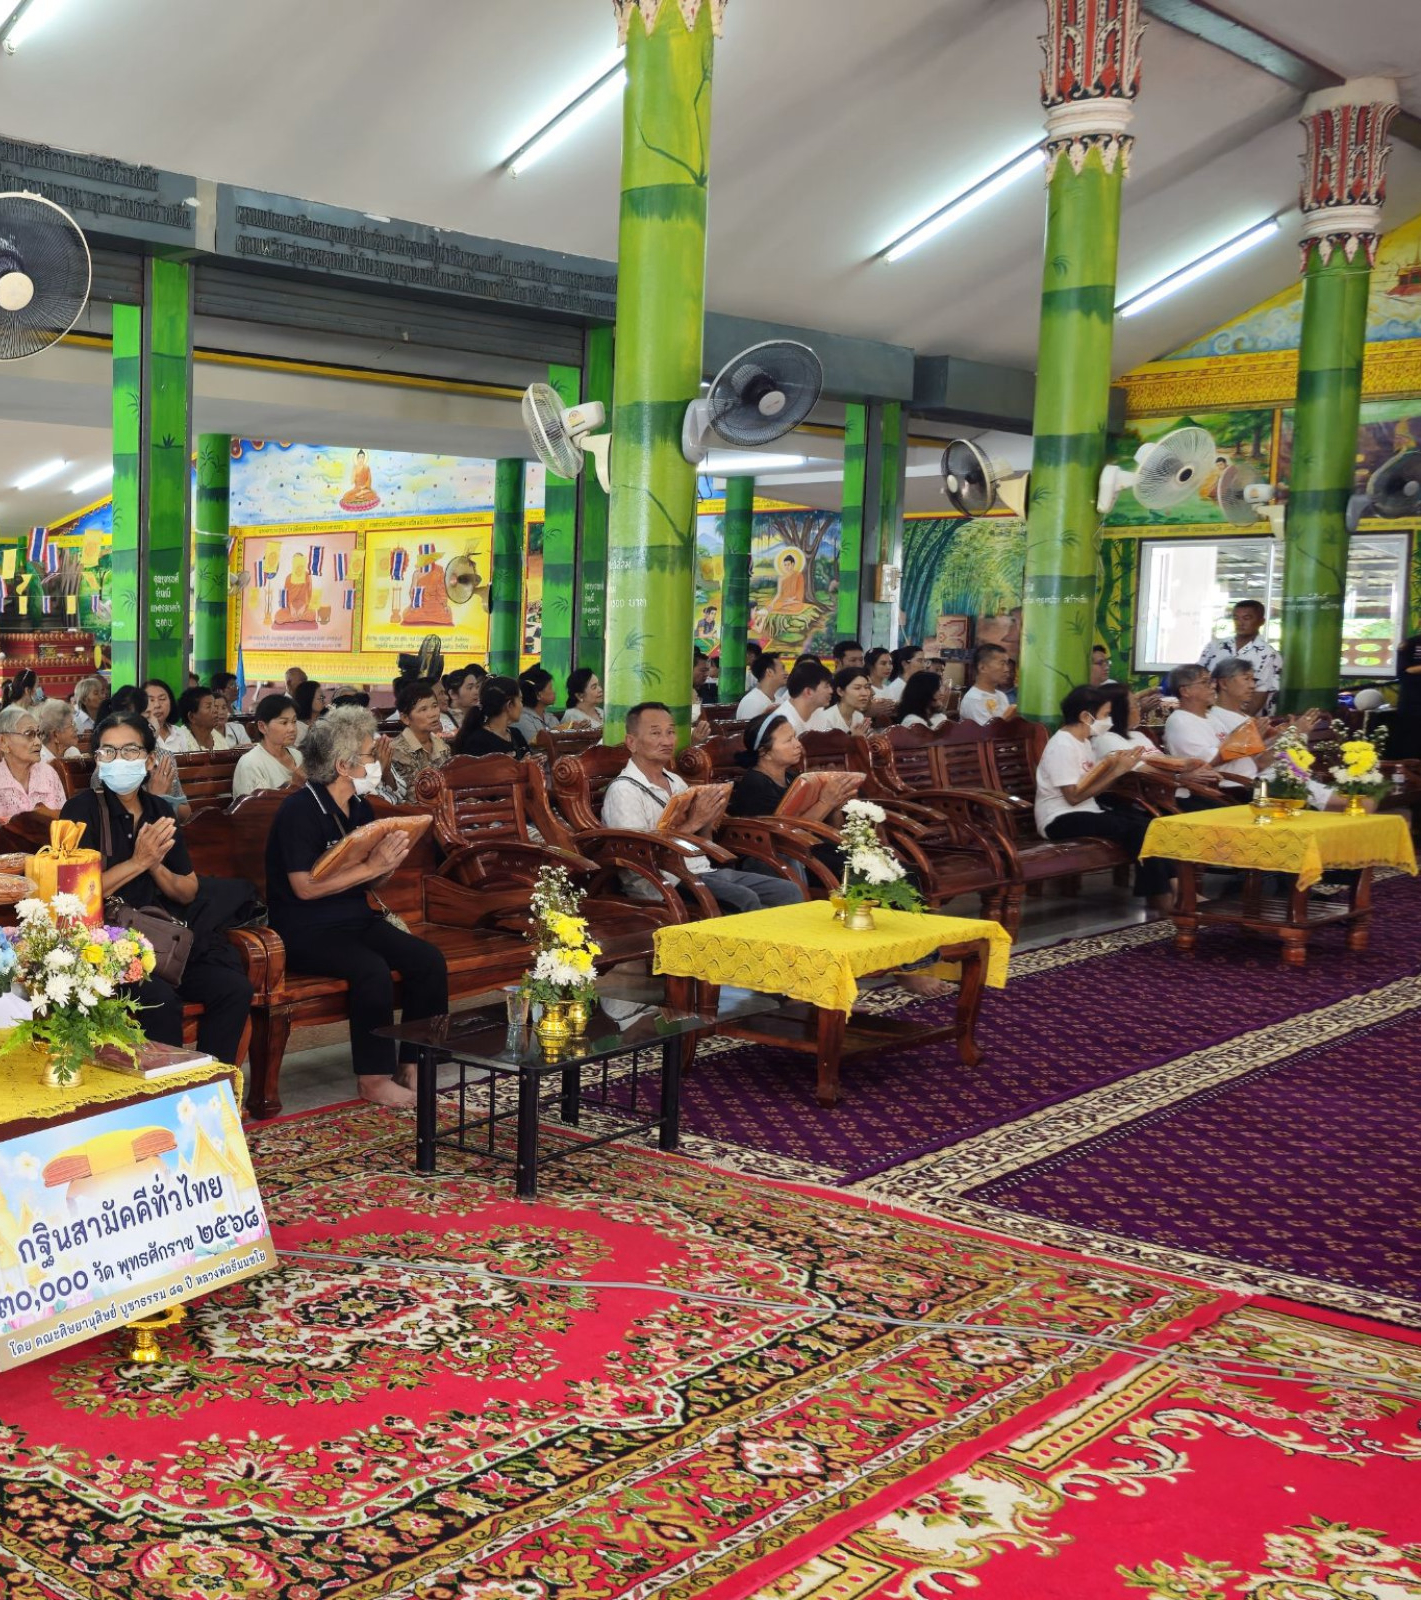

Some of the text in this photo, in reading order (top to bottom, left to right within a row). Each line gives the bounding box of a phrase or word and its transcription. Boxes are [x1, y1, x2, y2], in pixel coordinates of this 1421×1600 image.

[18, 1173, 223, 1268] กฐินสามัคคีทั่วไทย
[94, 1260, 114, 1283] วัด
[117, 1235, 194, 1281] พุทธศักราช
[197, 1205, 260, 1241] ๒๕๖๘
[9, 1341, 32, 1357] โดย
[35, 1303, 118, 1348] คณะศิษยานุศิษย์
[120, 1288, 167, 1319] บูชาธรรม
[185, 1275, 194, 1289] ปี
